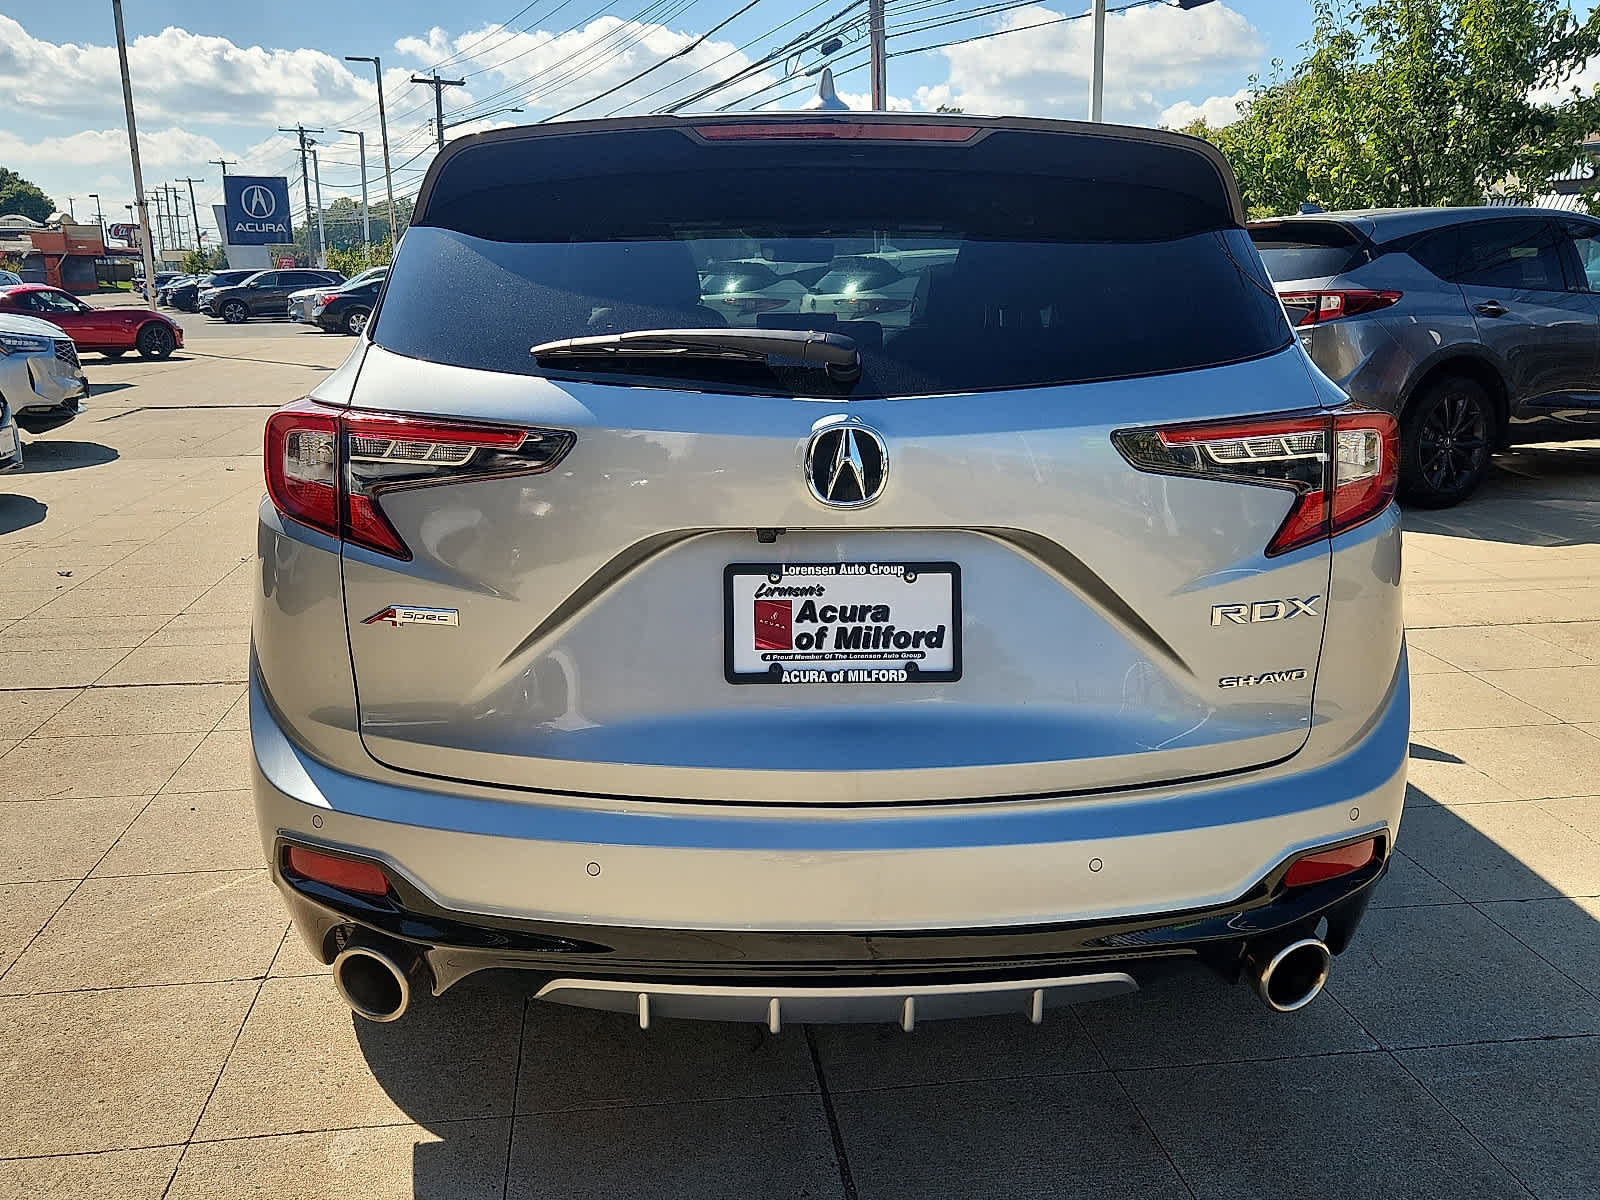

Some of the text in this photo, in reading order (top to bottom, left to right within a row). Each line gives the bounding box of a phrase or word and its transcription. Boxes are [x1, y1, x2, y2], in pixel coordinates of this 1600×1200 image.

[234, 222, 287, 233] ACURA
[781, 563, 905, 577] Lorensen Auto Group
[795, 600, 890, 624] Acura
[1210, 595, 1320, 627] RDX
[794, 624, 946, 651] of Milford
[781, 669, 908, 683] ACURA of MILFORD
